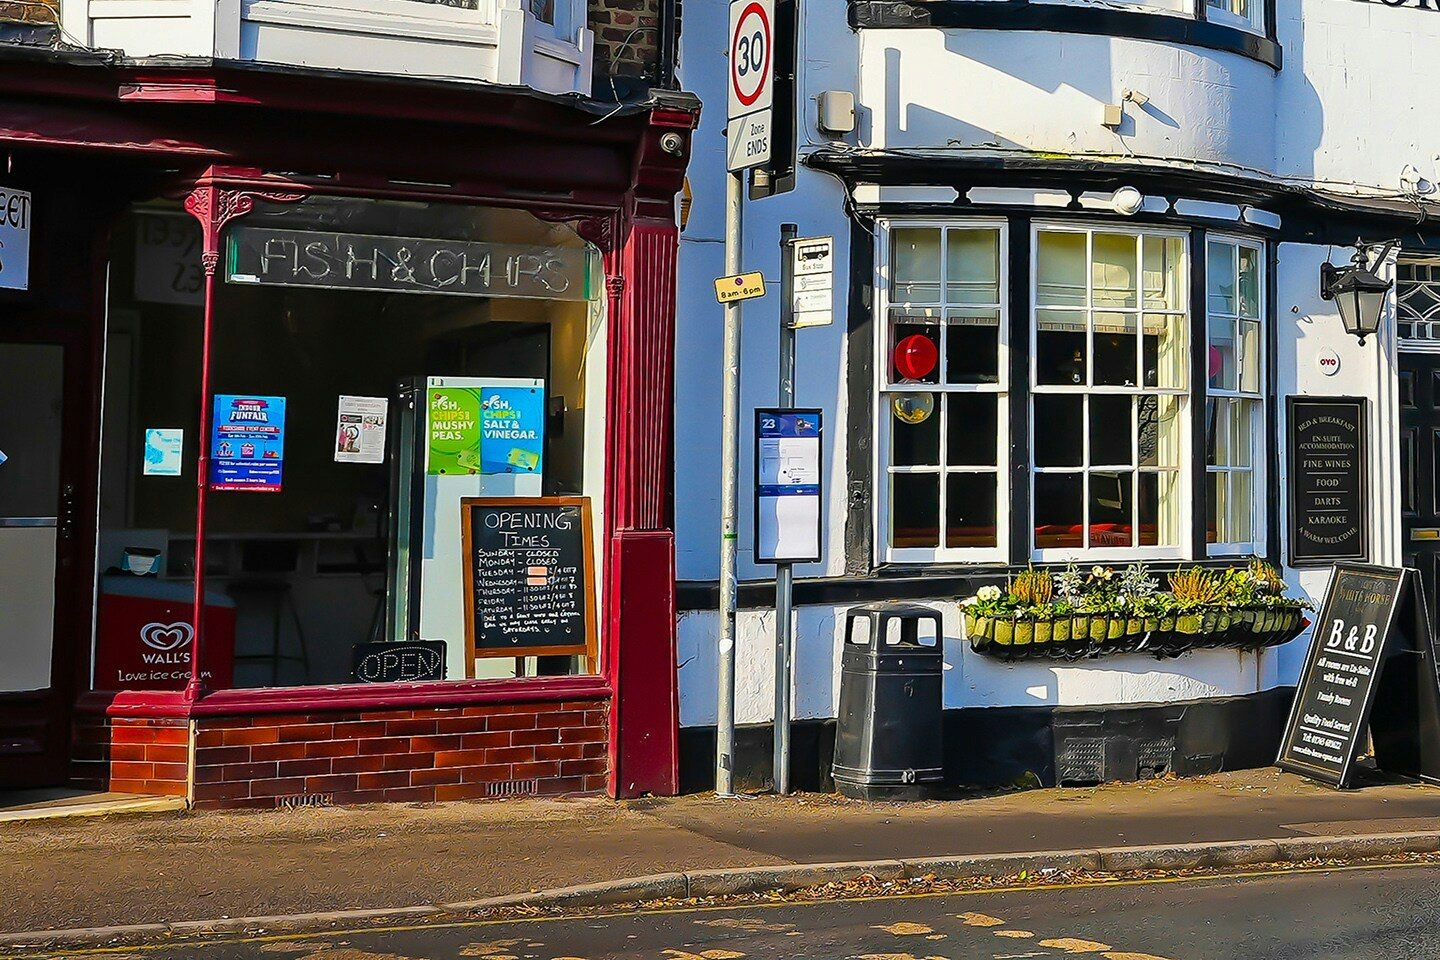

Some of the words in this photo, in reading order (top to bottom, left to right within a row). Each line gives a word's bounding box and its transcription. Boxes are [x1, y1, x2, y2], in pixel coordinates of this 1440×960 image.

[738, 31, 763, 77] 30
[750, 123, 765, 137] Zone
[747, 138, 768, 156] ENDS
[261, 238, 377, 281] FISH
[392, 246, 416, 282] &
[430, 249, 570, 293] CHIPS
[1320, 358, 1336, 366] OYO
[229, 411, 268, 422] FUNFAIR
[432, 421, 475, 430] MUSHY
[484, 420, 510, 429] SALT
[511, 421, 520, 429] &
[762, 418, 776, 429] 23
[1298, 420, 1312, 431] BED
[1318, 416, 1355, 432] BREAKFAST
[432, 431, 464, 440] PEAS.
[484, 430, 539, 439] VINEGAR.
[1303, 460, 1323, 468] FINE
[1324, 460, 1352, 468] WINES
[1316, 478, 1339, 487] FOOD
[1314, 497, 1341, 505] DARTS
[484, 512, 572, 530] OPENING
[1308, 516, 1348, 524] KARAOKE
[499, 531, 550, 547] TIMES
[1303, 530, 1324, 544] WARM
[1324, 527, 1358, 544] WELCOME
[478, 548, 515, 558] SUNDAY
[478, 558, 516, 567] MONDAY
[526, 558, 558, 566] CLOSED
[478, 568, 514, 577] TUESDAY
[1327, 619, 1345, 648] B
[1344, 625, 1359, 651] &
[1360, 624, 1378, 654] B
[141, 652, 191, 664] WALL'S
[363, 652, 436, 680] OPEN
[1317, 657, 1326, 667] All
[1325, 661, 1341, 670] rooms
[1341, 664, 1350, 672] are
[1350, 664, 1371, 676] En-Suite
[118, 669, 147, 682] Love
[150, 670, 169, 681] ice
[170, 670, 212, 681] crem
[1323, 672, 1335, 683] with
[1334, 674, 1346, 685] free
[1317, 691, 1335, 705] Family
[1334, 694, 1352, 707] Rooms
[1303, 713, 1322, 727] Quality
[1321, 717, 1335, 728] Food
[1334, 719, 1353, 733] Served
